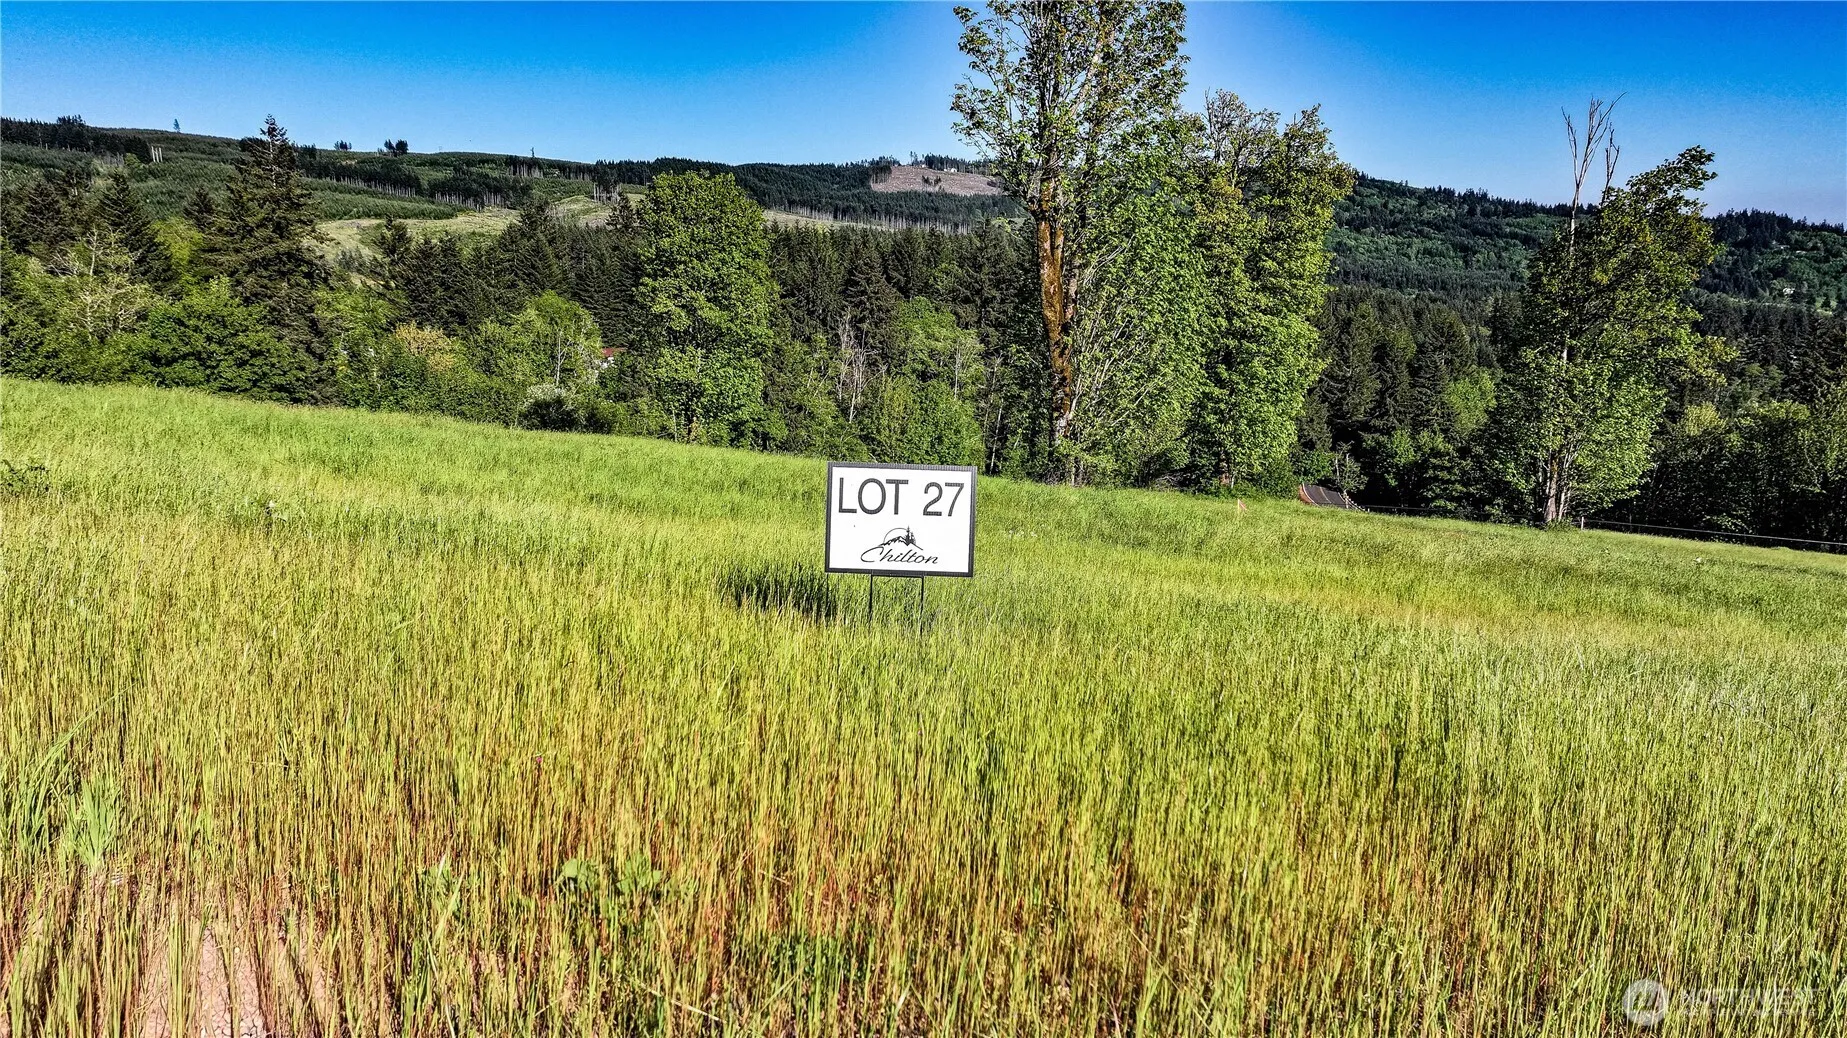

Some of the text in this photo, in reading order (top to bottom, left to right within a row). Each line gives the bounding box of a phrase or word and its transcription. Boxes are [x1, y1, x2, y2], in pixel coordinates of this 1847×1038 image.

[838, 477, 965, 517] LOT 27
[860, 546, 938, 564] Chilton
